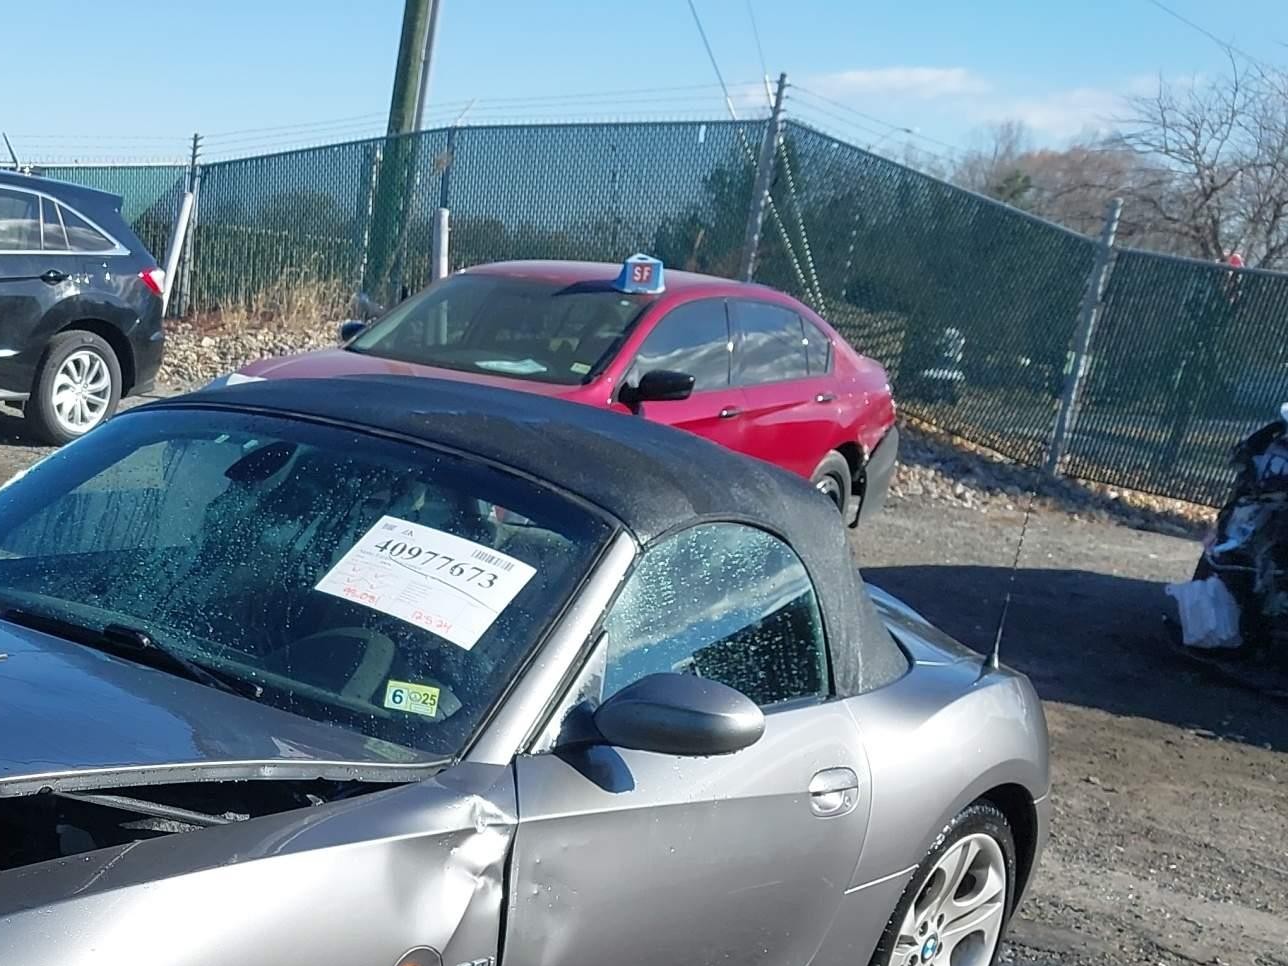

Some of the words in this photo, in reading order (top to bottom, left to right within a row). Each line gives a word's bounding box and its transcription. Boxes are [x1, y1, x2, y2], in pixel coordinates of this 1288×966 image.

[633, 265, 651, 281] SF
[374, 539, 498, 588] 40977673
[392, 688, 404, 705] 6
[422, 692, 437, 706] 25
